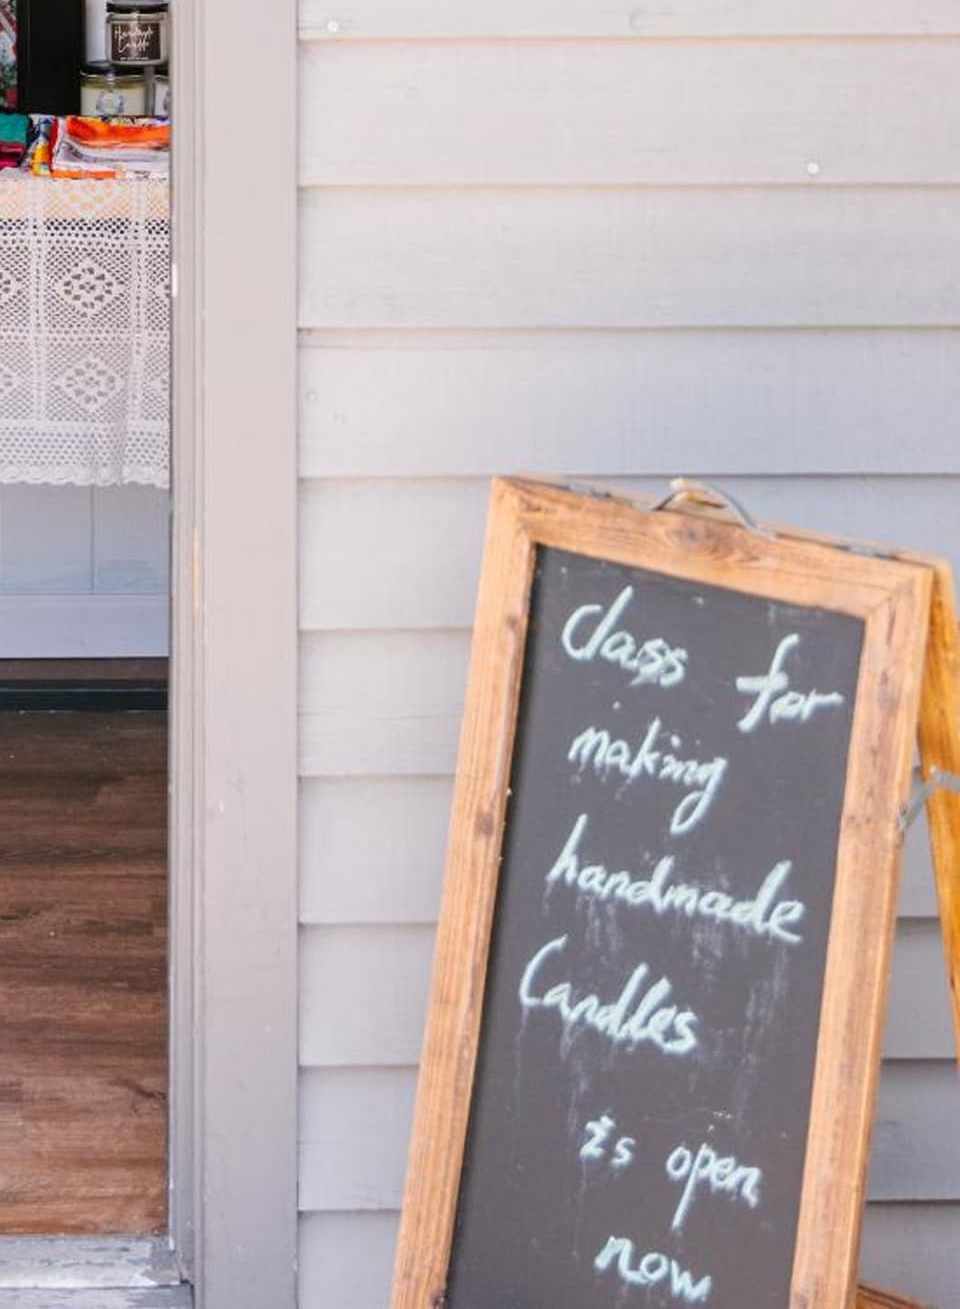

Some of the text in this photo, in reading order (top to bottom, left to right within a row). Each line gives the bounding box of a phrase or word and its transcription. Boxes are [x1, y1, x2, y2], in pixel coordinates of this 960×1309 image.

[735, 633, 844, 733] for
[567, 715, 728, 835] making
[546, 814, 805, 943] handmade
[519, 934, 699, 1055] Candles
[579, 1113, 762, 1231] is open
[594, 1235, 712, 1302] now
